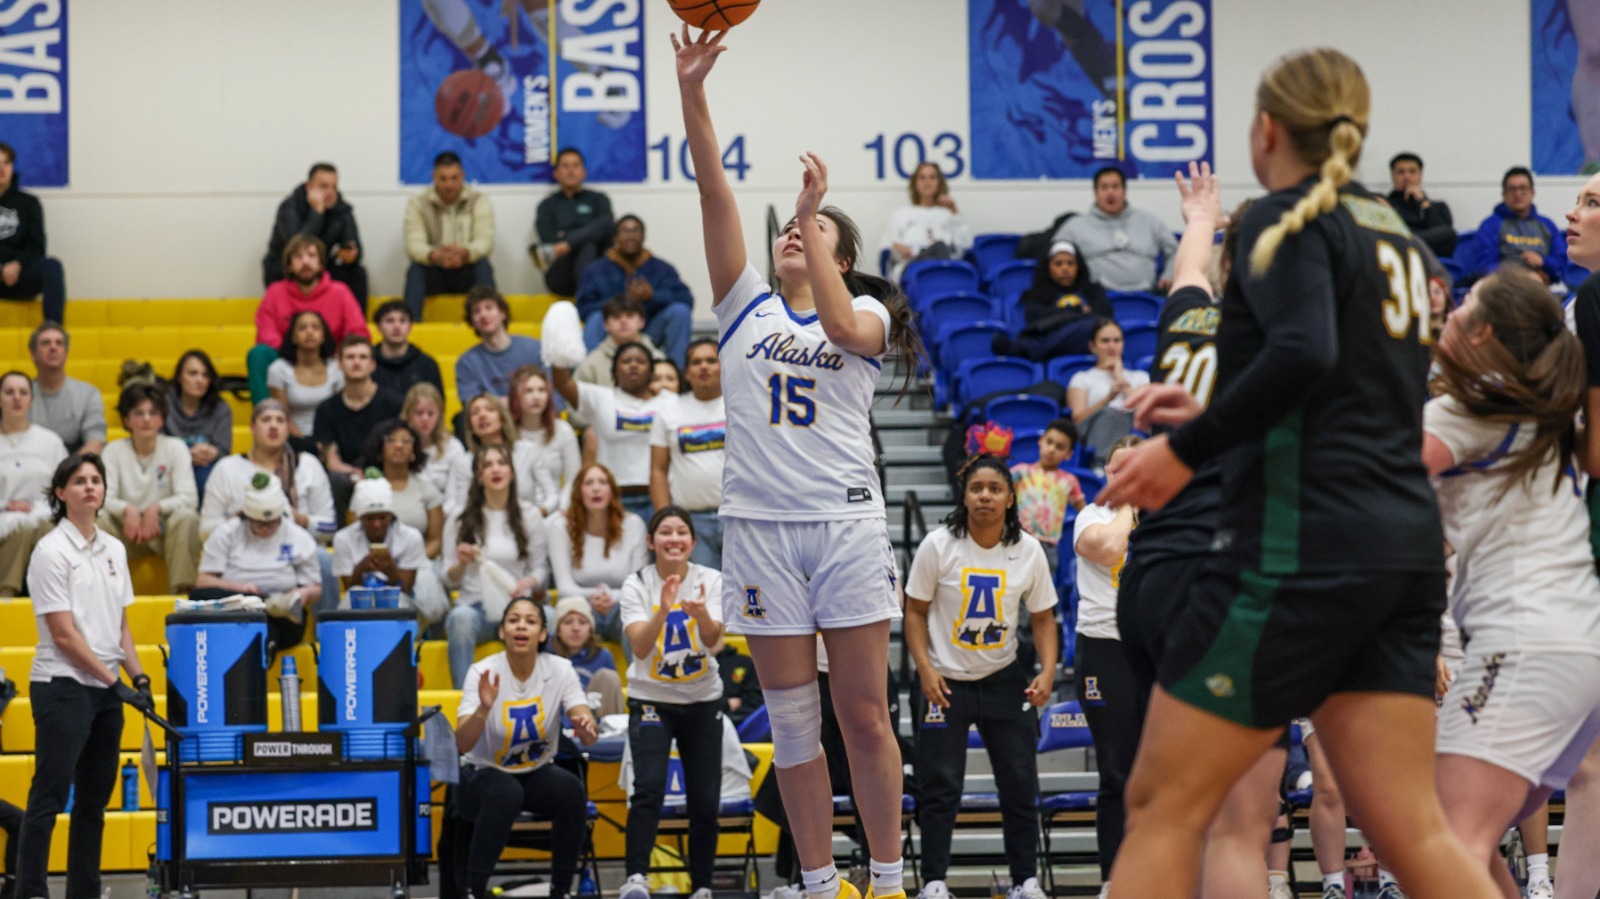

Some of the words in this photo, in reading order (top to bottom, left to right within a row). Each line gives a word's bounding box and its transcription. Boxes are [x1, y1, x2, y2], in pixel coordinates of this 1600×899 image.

[562, 0, 641, 112] BAS
[1128, 0, 1207, 162] CROS
[524, 74, 549, 164] WOMEN'S
[1092, 99, 1117, 158] MEN'S
[864, 132, 965, 180] 103
[1376, 239, 1431, 344] 34
[746, 332, 844, 371] Alaska
[1160, 341, 1219, 407] 20
[768, 372, 816, 428] 15
[196, 630, 208, 723] POWERADE
[345, 627, 357, 721] POWERADE
[256, 744, 290, 755] POWER
[292, 743, 332, 755] THROUGH
[212, 802, 373, 830] POWERADE
